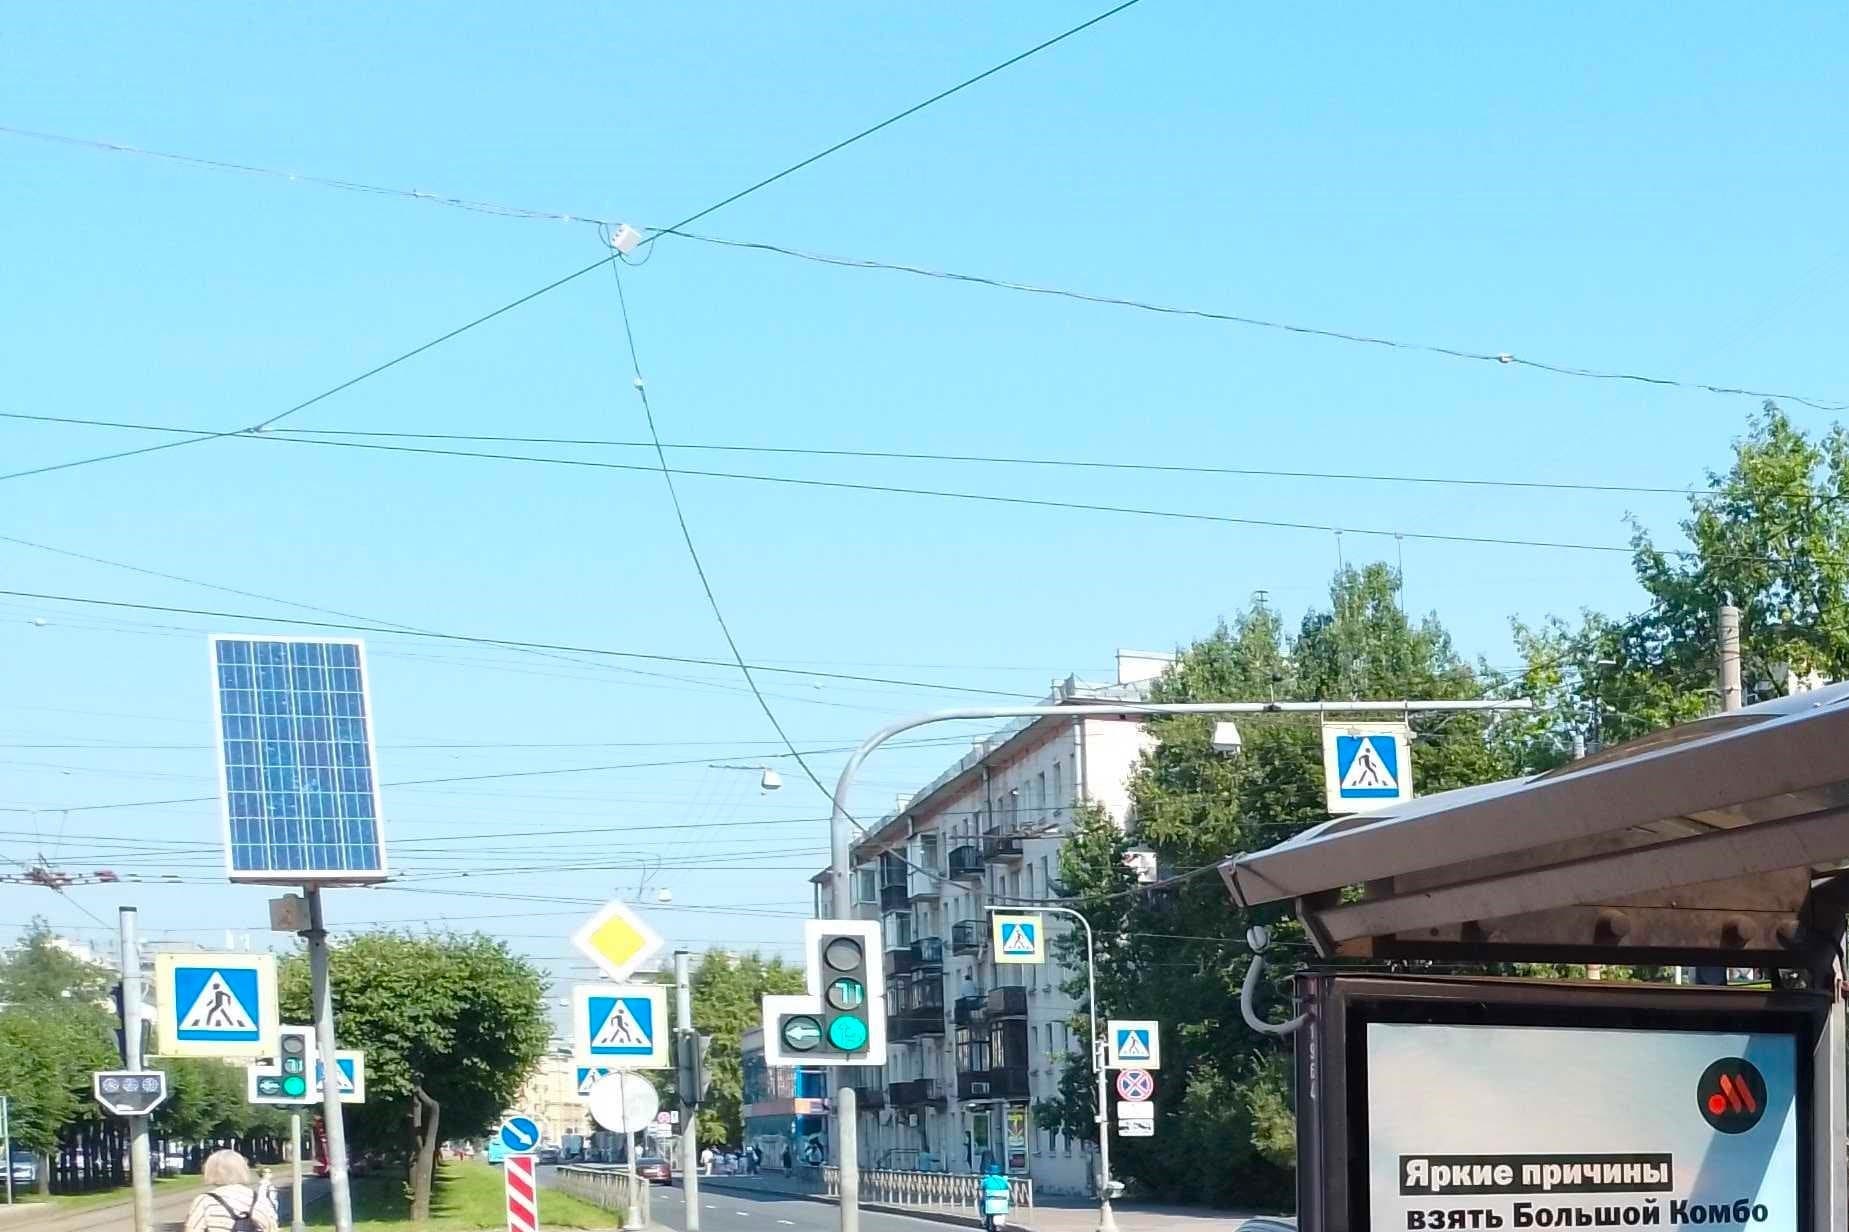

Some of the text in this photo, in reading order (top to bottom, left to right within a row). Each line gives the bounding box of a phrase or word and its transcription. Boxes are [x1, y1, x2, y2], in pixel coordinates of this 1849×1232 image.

[1405, 1159, 1669, 1192] Яркие причины
[1407, 1198, 1769, 1230] взять Большой Комбо
